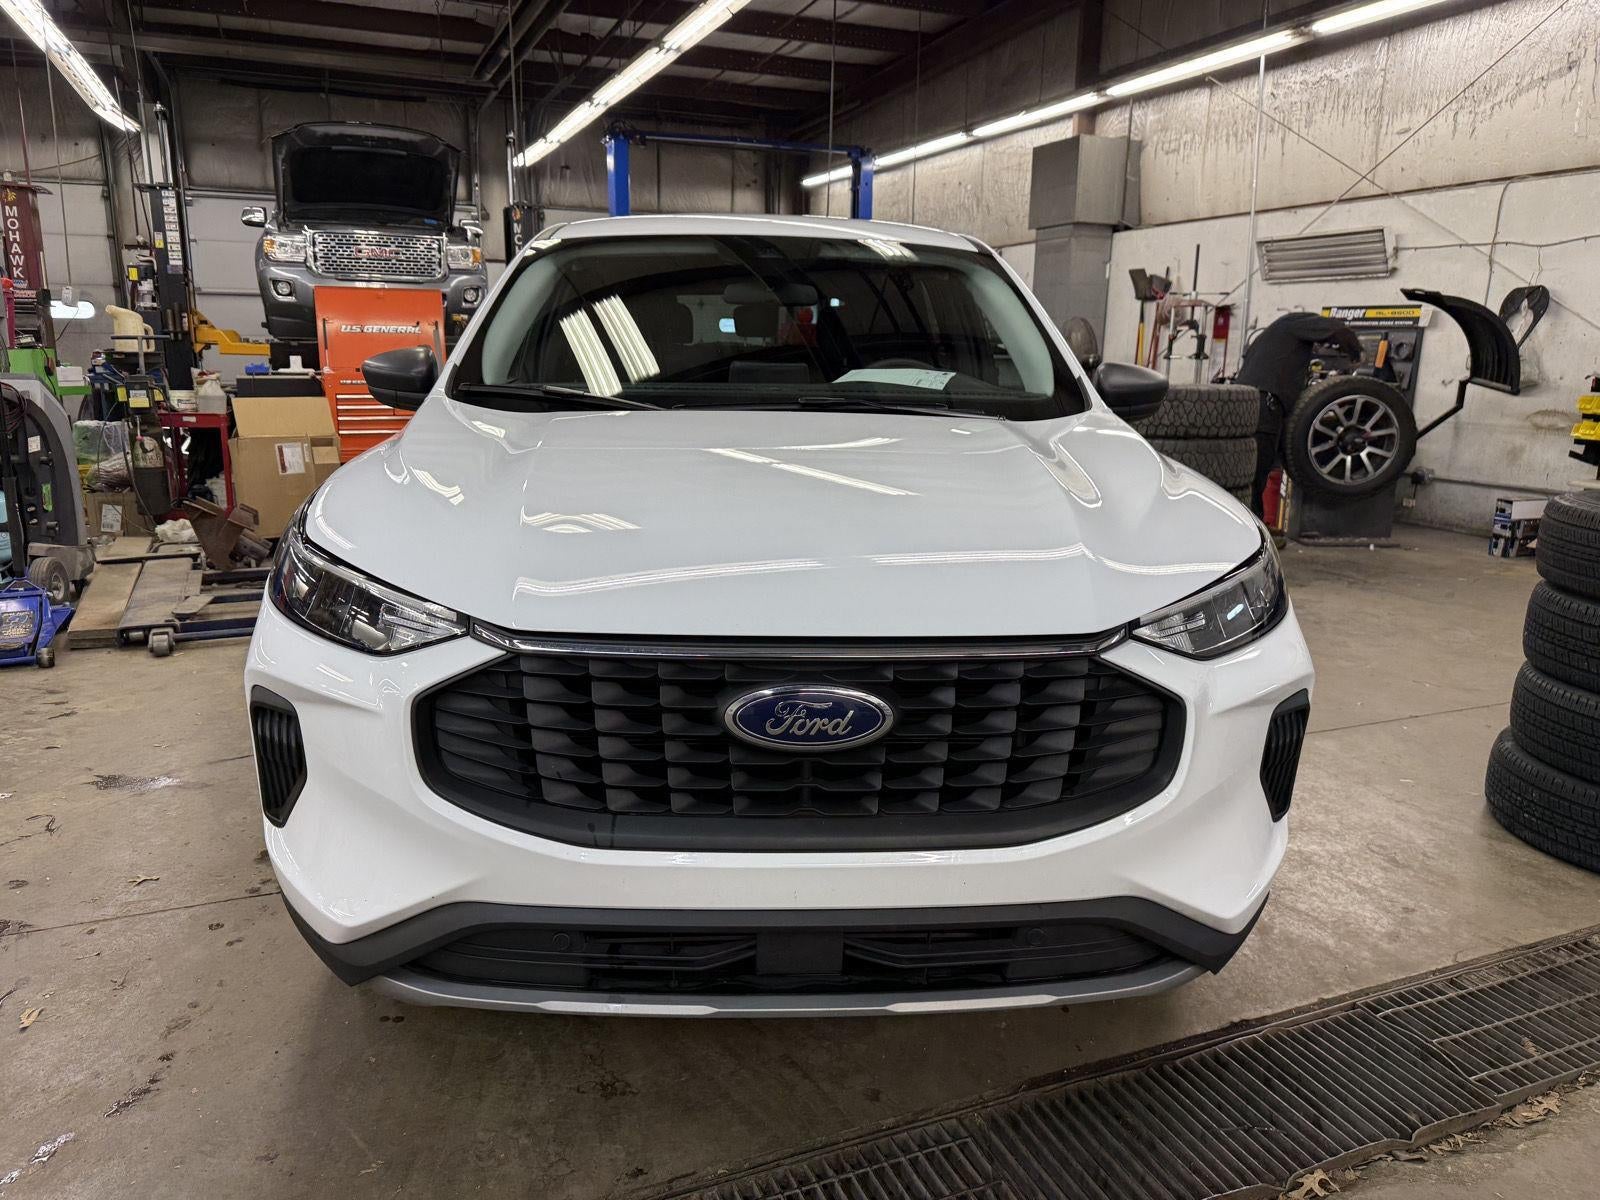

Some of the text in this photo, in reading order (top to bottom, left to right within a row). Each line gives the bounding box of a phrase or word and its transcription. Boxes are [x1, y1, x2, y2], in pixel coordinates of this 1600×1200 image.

[5, 206, 24, 278] MOHAWK
[354, 246, 403, 259] GMC
[1329, 307, 1366, 320] Ranger
[765, 700, 854, 736] Ford
